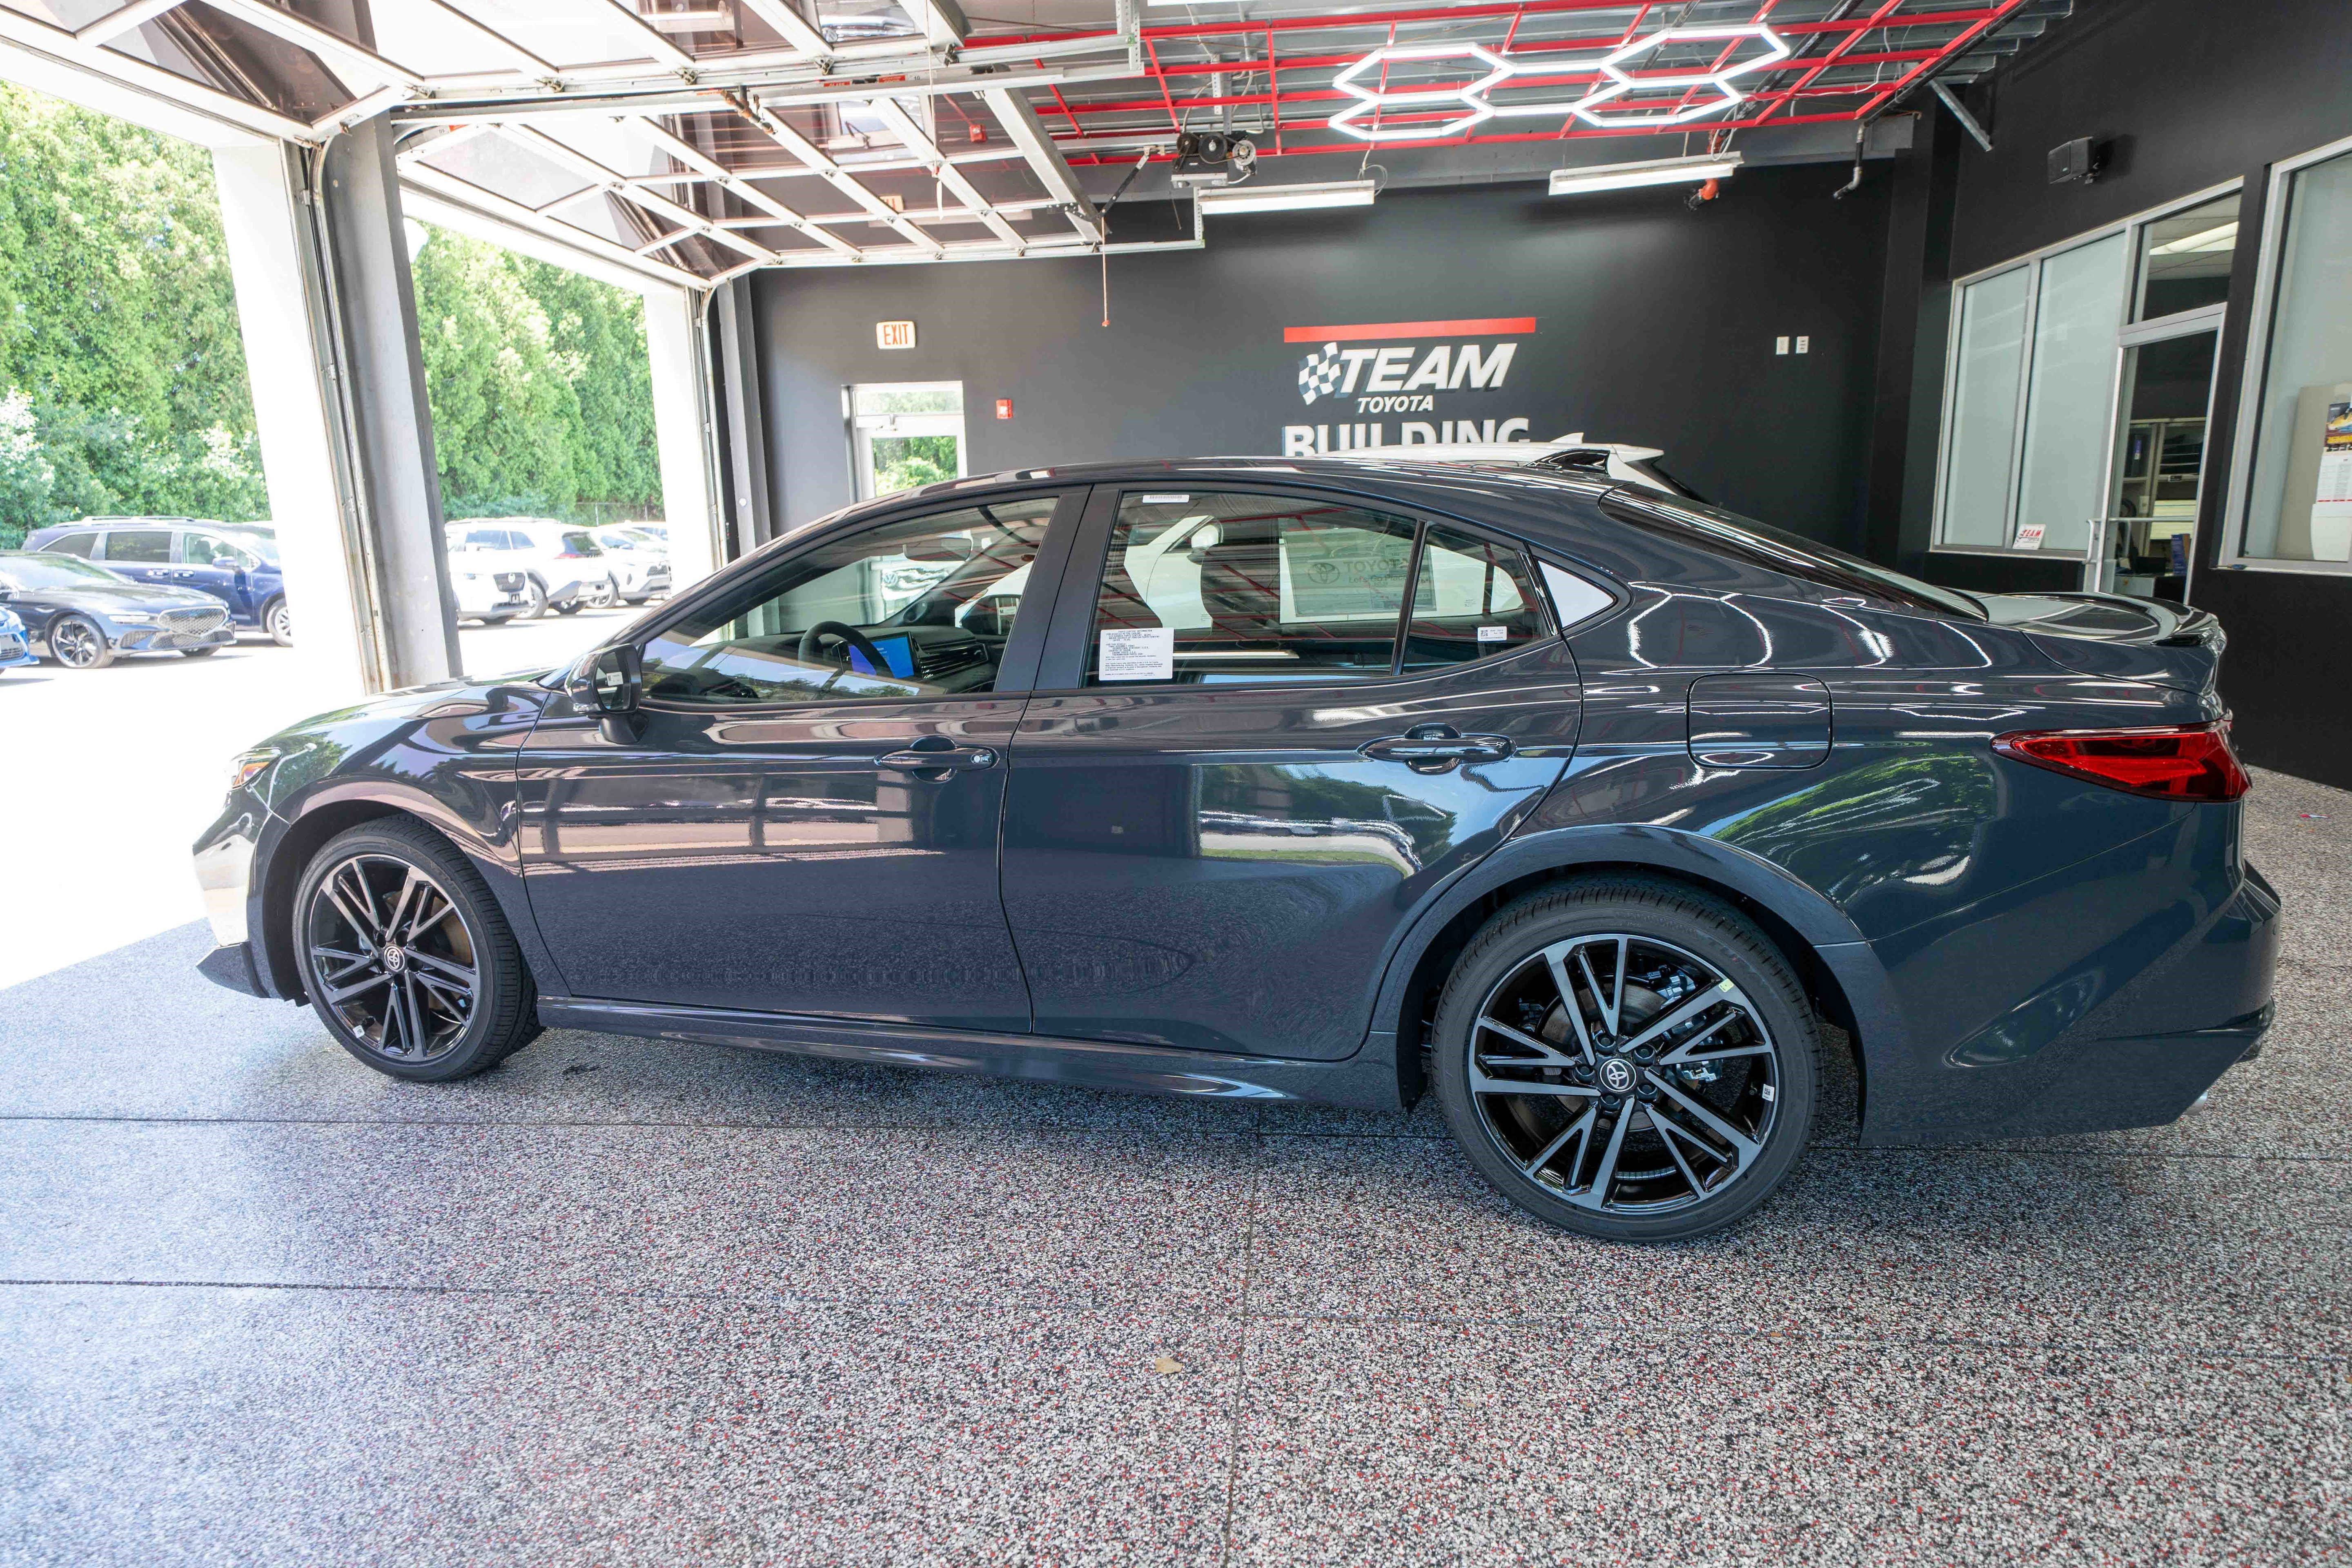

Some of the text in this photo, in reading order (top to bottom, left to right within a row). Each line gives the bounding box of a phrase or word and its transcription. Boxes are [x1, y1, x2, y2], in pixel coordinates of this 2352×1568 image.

[884, 324, 908, 345] EXIT
[1337, 343, 1517, 394] TEAM
[1357, 395, 1434, 414] TOYOTA
